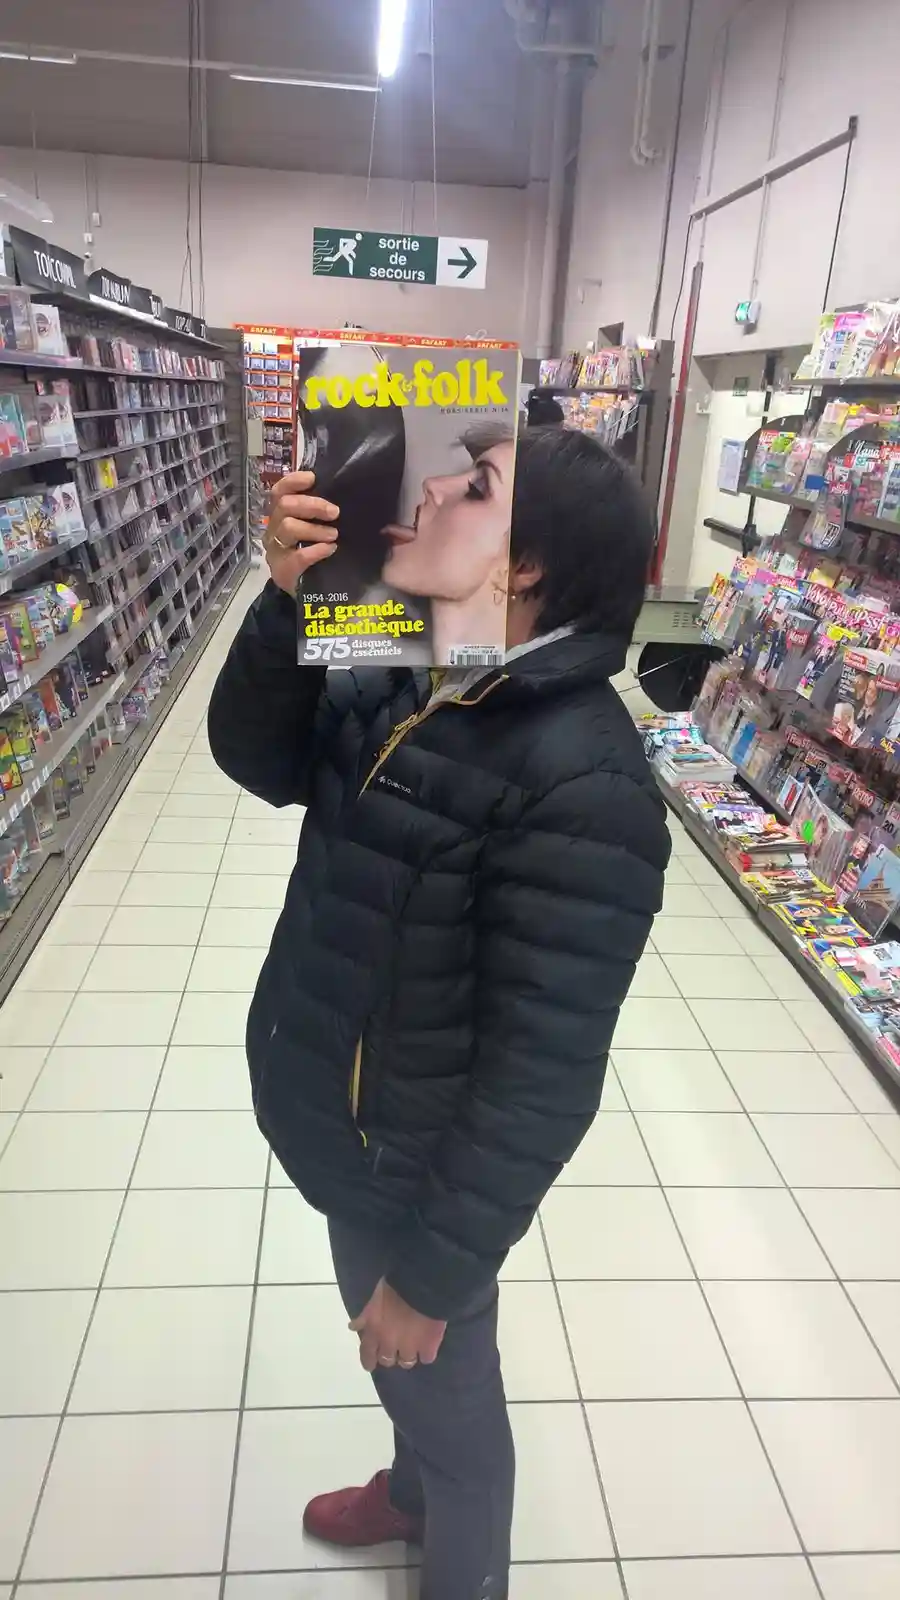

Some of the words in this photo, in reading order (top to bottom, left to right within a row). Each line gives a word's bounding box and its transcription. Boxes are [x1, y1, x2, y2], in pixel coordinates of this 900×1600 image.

[378, 237, 420, 251] sortie
[389, 252, 407, 266] de
[369, 266, 426, 281] secours
[303, 603, 331, 620] La
[334, 599, 405, 622] grande
[304, 617, 425, 638] discothèque
[303, 637, 351, 660] 575
[351, 639, 393, 651] disques
[352, 647, 403, 657] essentiels
